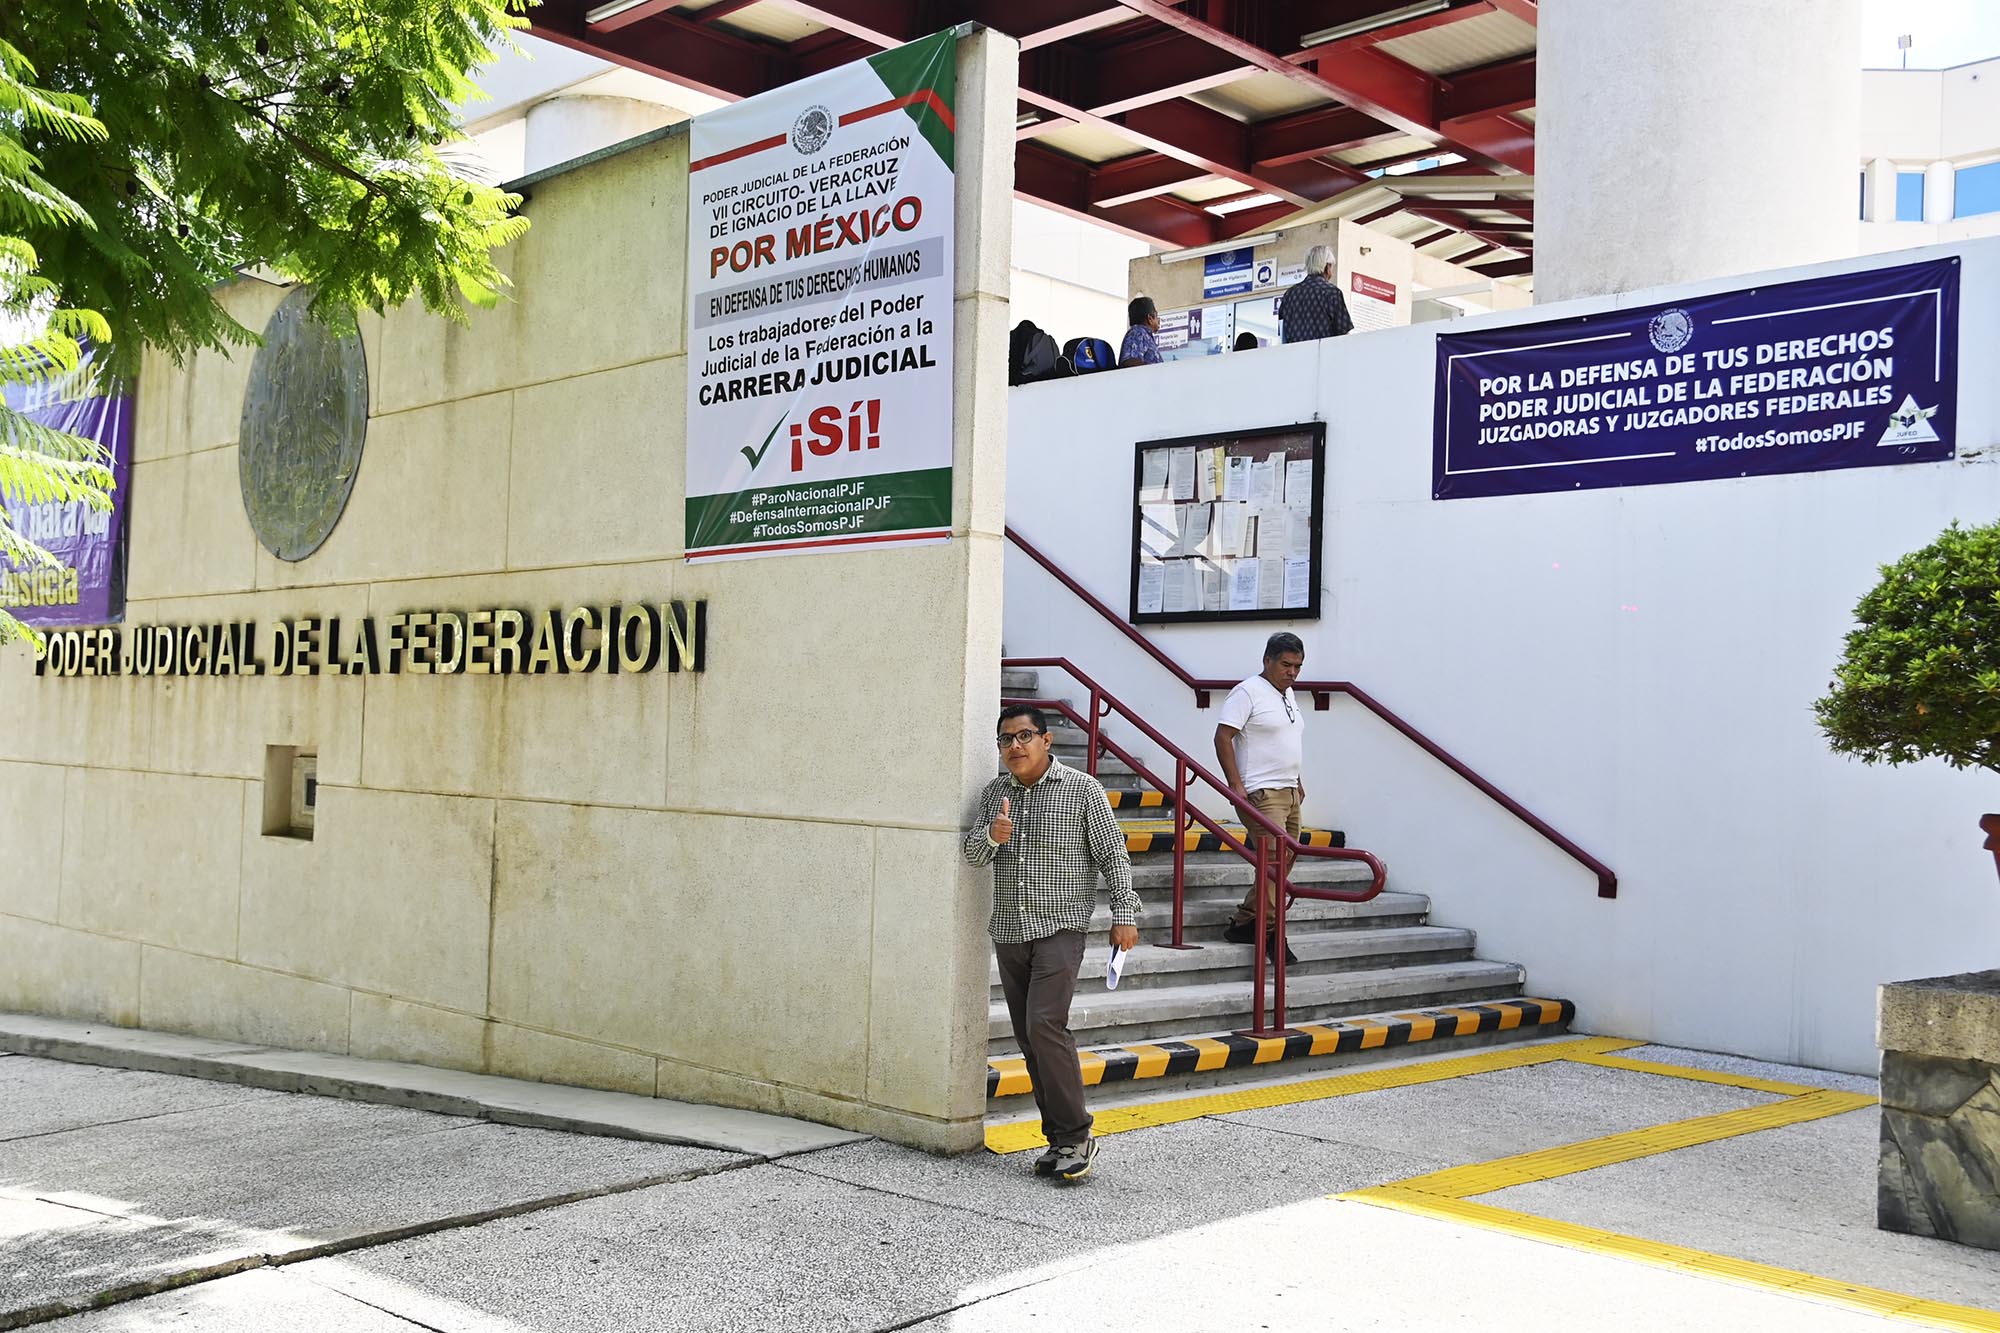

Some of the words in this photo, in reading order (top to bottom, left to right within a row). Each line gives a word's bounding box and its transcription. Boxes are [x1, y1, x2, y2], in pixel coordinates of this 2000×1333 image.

[704, 186, 738, 205] PODER
[741, 171, 789, 194] JUDICIAL
[792, 166, 808, 180] DE
[811, 162, 826, 174] LA
[829, 137, 910, 168] FEDERACIÓN
[712, 204, 729, 221] VII
[732, 186, 805, 216] CIRCUITO-
[810, 158, 898, 192] VERACRUZ
[710, 224, 728, 238] DE
[732, 204, 791, 233] IGNACIO
[796, 200, 814, 216] DE
[822, 192, 840, 209] LA
[846, 176, 897, 203] LLAVE
[711, 232, 776, 278] POR
[786, 196, 922, 260] MÉXICO
[711, 300, 723, 318] EN
[725, 290, 768, 314] DEFENSA
[770, 284, 783, 304] DE
[785, 279, 805, 301] TUS
[807, 268, 861, 296] DERECHOS
[863, 250, 920, 280] HUMANOS
[701, 351, 757, 378] Judicial
[761, 348, 780, 367] de
[784, 344, 799, 361] la
[806, 325, 895, 359] Federación
[900, 324, 910, 338] a
[917, 318, 933, 335] la
[708, 335, 734, 352] Los
[739, 312, 836, 348] trabajadores
[840, 303, 864, 324] del
[870, 294, 924, 318] Poder
[699, 369, 806, 406] CARRERA
[810, 345, 936, 386] JUDICIAL
[1479, 399, 1547, 423] PODER
[1553, 386, 1652, 413] JUDICIAL
[1658, 383, 1687, 401] DE
[1693, 378, 1723, 397] LA
[1730, 353, 1893, 394] FEDERACIÓN
[1480, 375, 1522, 397] POR
[1528, 370, 1553, 390] LA
[1560, 359, 1657, 387] DEFENSA
[1665, 354, 1696, 376] DE
[1703, 347, 1748, 370] TUS
[1756, 327, 1894, 364] DERECHOS
[790, 399, 881, 472] ¡Sí!
[1478, 416, 1600, 445] JUZGADORAS
[1607, 414, 1618, 432] Y
[1624, 399, 1760, 431] JUZGADORES
[1766, 385, 1893, 415] FEDERALES
[1695, 421, 1865, 453] #TodosSomosPJF
[30, 500, 77, 543] para
[730, 496, 891, 524] #DefensaInternacionalPJF
[752, 482, 865, 506] #ParoNacionalPJF
[753, 515, 864, 538] #TodosSomosPJF
[34, 628, 114, 676] PODER
[126, 623, 258, 676] JUDICIAL
[272, 618, 318, 676] DE
[326, 616, 371, 674] LA
[385, 602, 700, 674] FEDERACION
